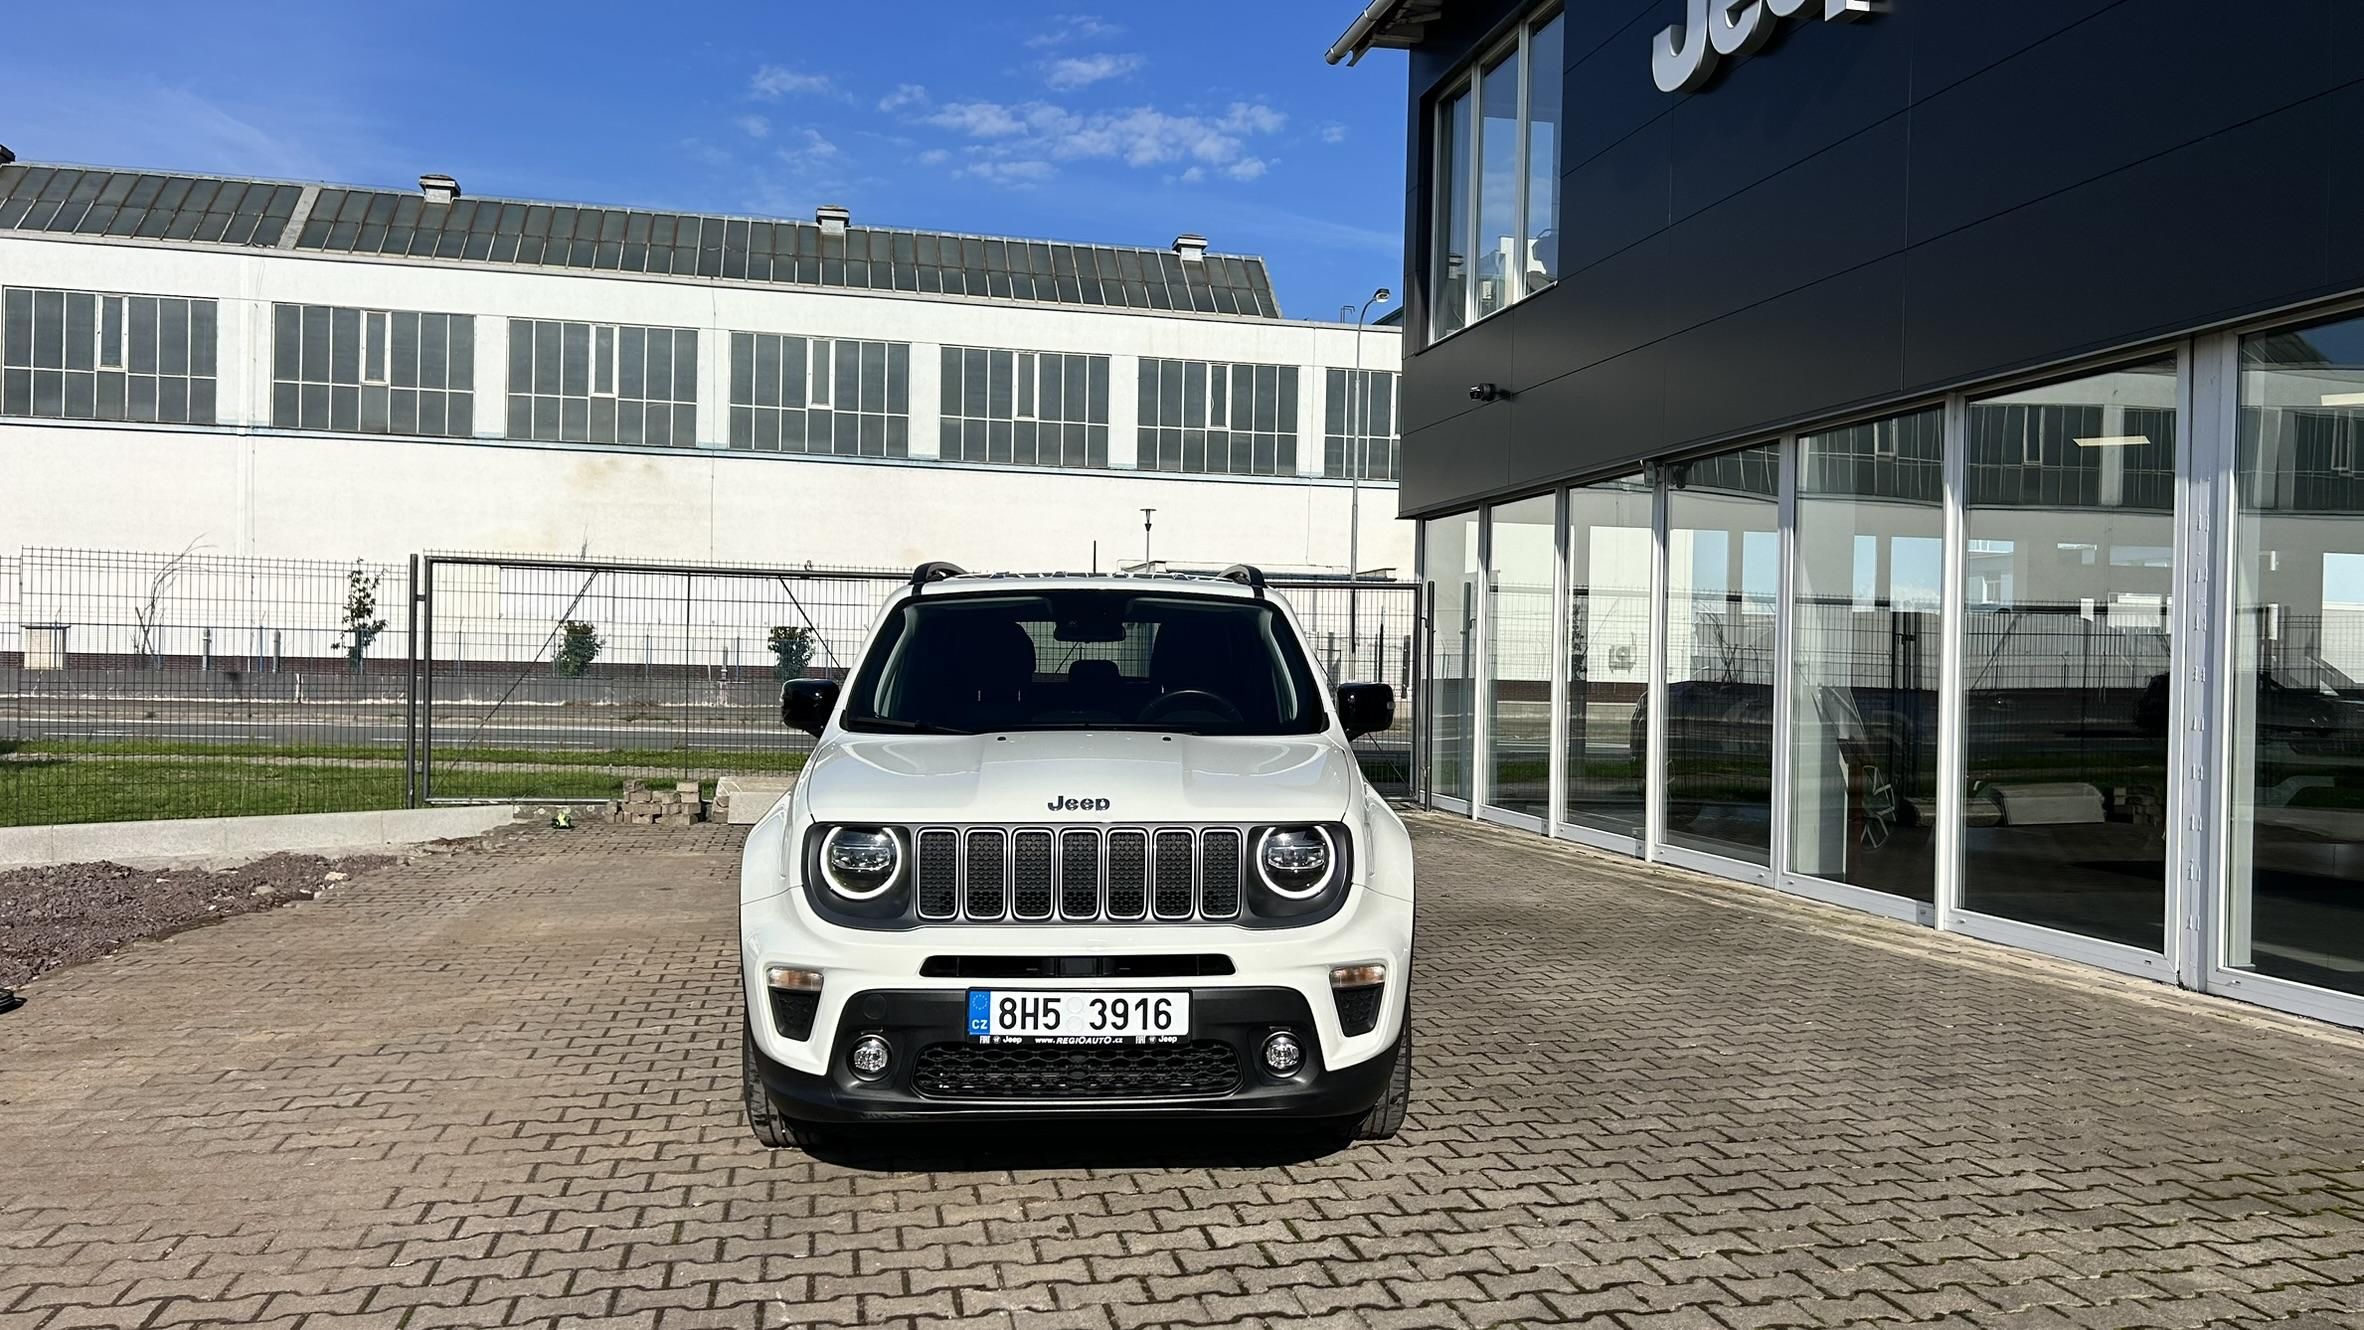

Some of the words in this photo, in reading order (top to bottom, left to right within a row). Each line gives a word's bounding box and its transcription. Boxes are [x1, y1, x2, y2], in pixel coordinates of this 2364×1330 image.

[1652, 0, 1872, 93] Je
[1047, 795, 1110, 811] Jeep
[999, 997, 1061, 1030] 8H5
[1089, 997, 1172, 1030] 3916
[971, 1019, 988, 1030] CZ
[1002, 1035, 1023, 1045] Jeep
[1034, 1036, 1123, 1045] www.REGIOAUTO.cz
[1158, 1035, 1178, 1044] Jeep
